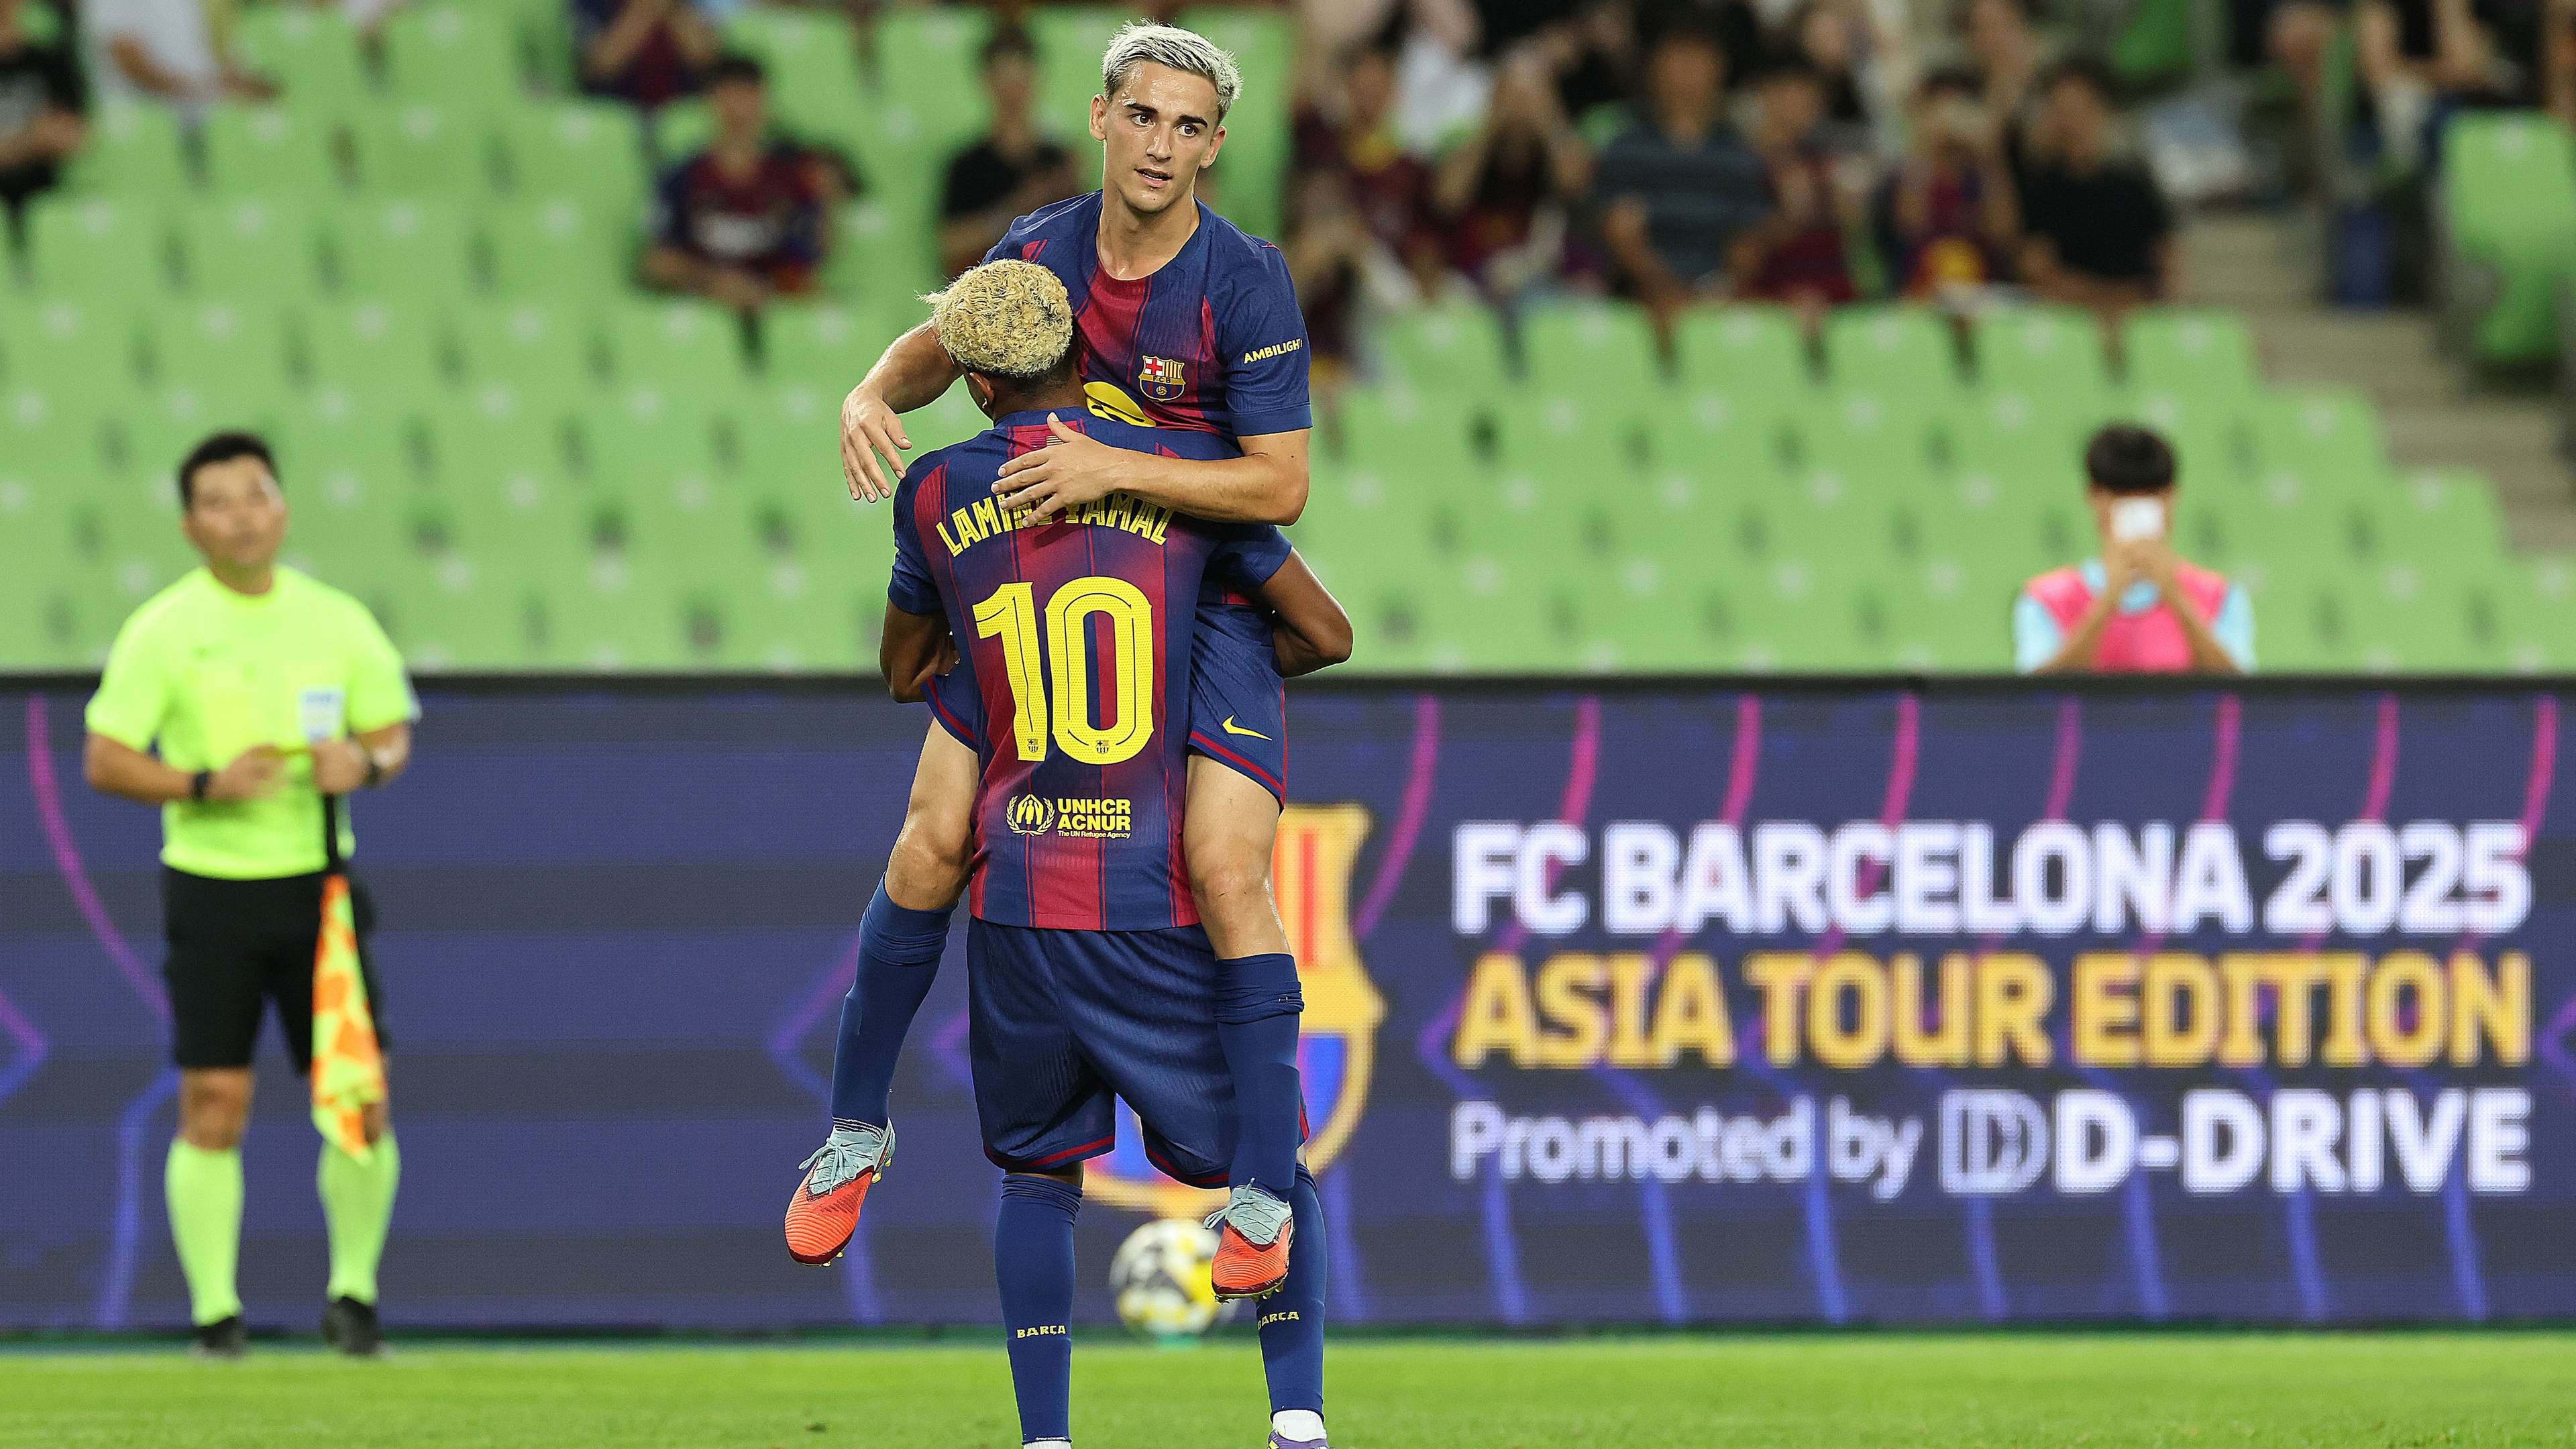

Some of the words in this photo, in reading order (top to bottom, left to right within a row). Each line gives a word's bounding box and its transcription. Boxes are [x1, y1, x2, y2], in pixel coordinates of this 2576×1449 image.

[971, 576, 1155, 765] 10
[1057, 798, 1132, 814] UNHCR
[1057, 814, 1132, 830] ACNUR
[1450, 819, 1589, 934] FC
[1604, 819, 2253, 934] BARCELONA
[2262, 819, 2533, 934] 2025
[1454, 951, 1737, 1067] ASIA
[1743, 951, 2056, 1067] TOUR
[2072, 951, 2532, 1067] EDITION
[1450, 1095, 1815, 1184] Promoted
[1827, 1095, 1923, 1199] by
[2054, 1088, 2532, 1195] D-DRIVE
[1016, 1325, 1066, 1338] BARÇA
